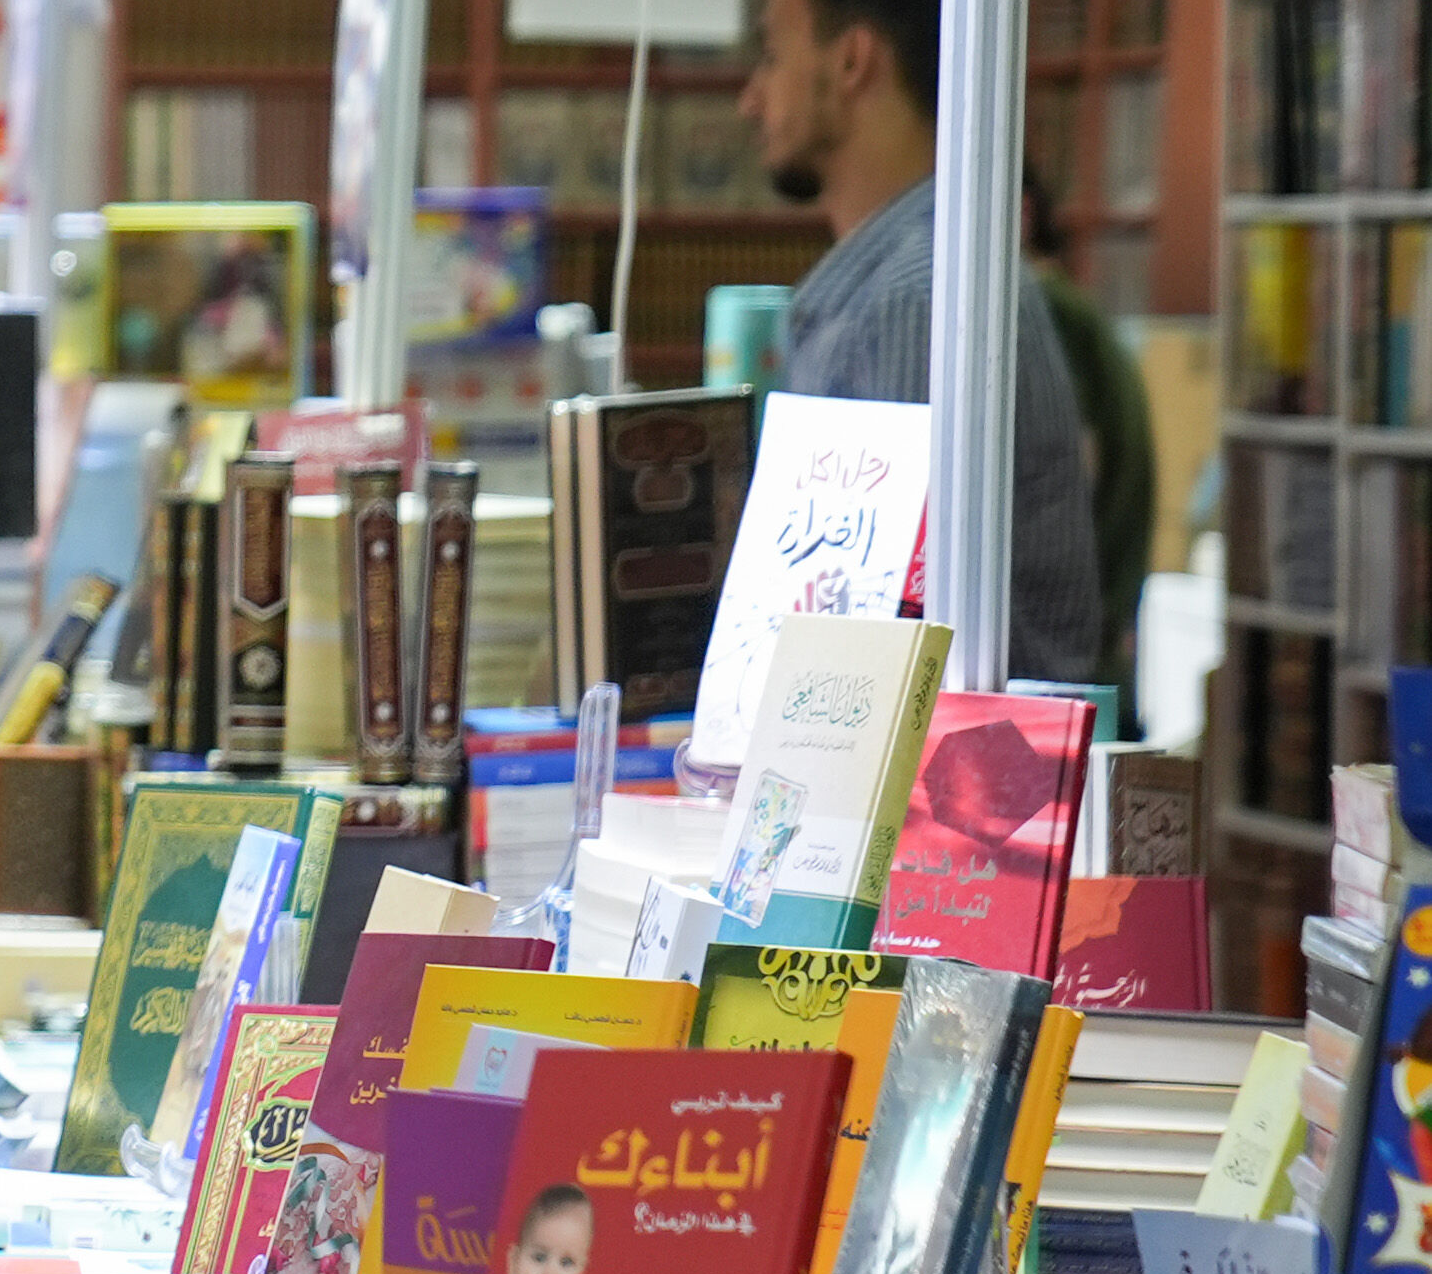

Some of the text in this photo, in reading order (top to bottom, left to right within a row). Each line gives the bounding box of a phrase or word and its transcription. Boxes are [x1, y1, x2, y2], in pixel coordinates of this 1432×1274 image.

[957, 853, 998, 886] هل
[895, 888, 926, 919] من
[363, 1035, 410, 1060] فسك
[728, 1091, 785, 1114] كيف
[576, 1116, 775, 1211] أبناءك
